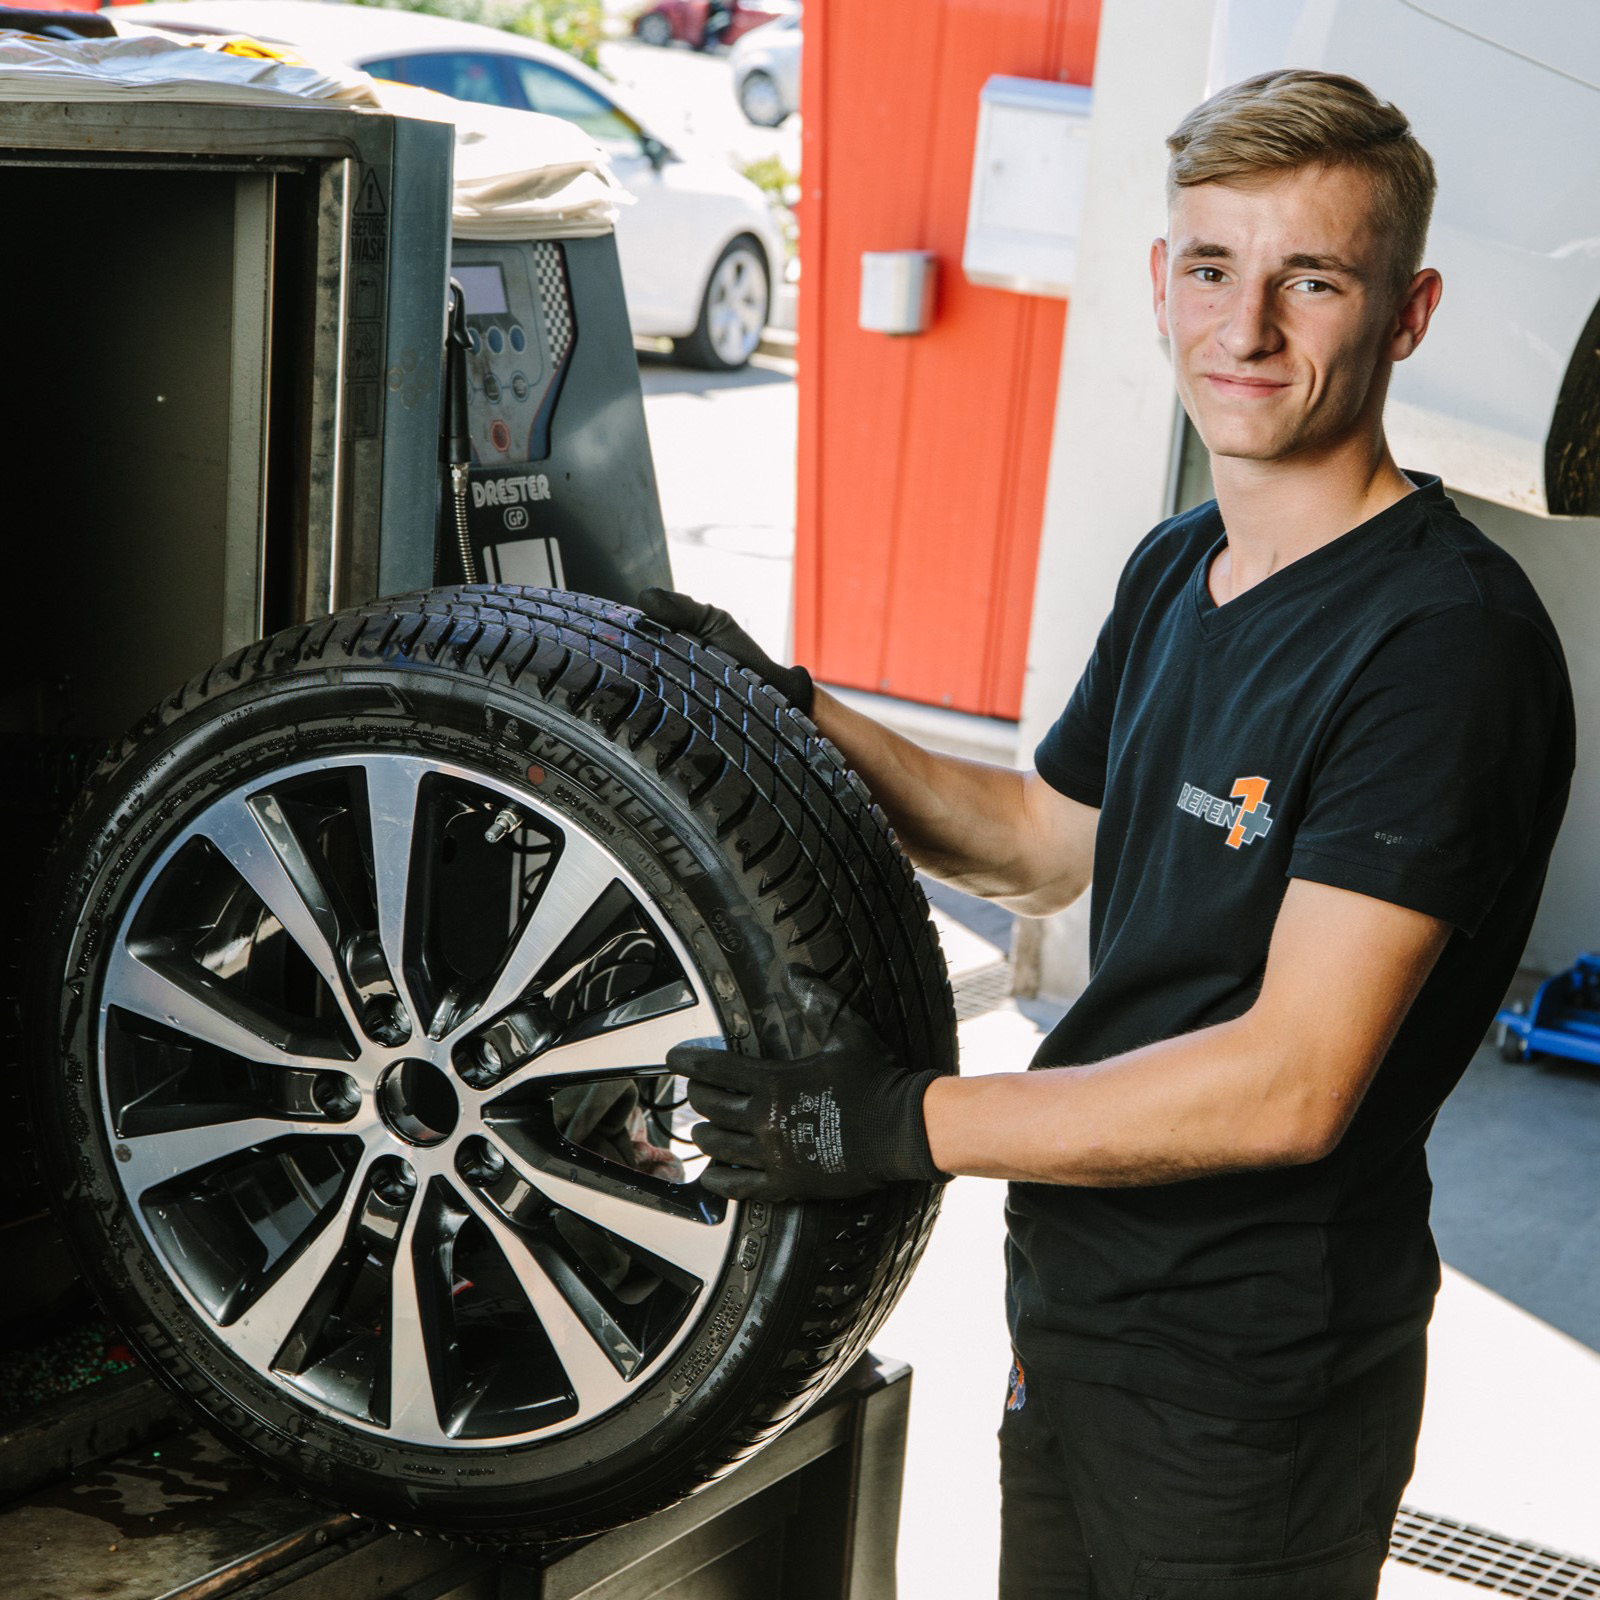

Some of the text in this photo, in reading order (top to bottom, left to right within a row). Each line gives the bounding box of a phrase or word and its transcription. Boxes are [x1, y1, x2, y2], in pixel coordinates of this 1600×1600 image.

[352, 217, 386, 236] BEFORE
[351, 237, 385, 261] WASH
[471, 474, 551, 508] DRESTER
[508, 510, 524, 526] GP
[528, 731, 708, 880] MICHELIN
